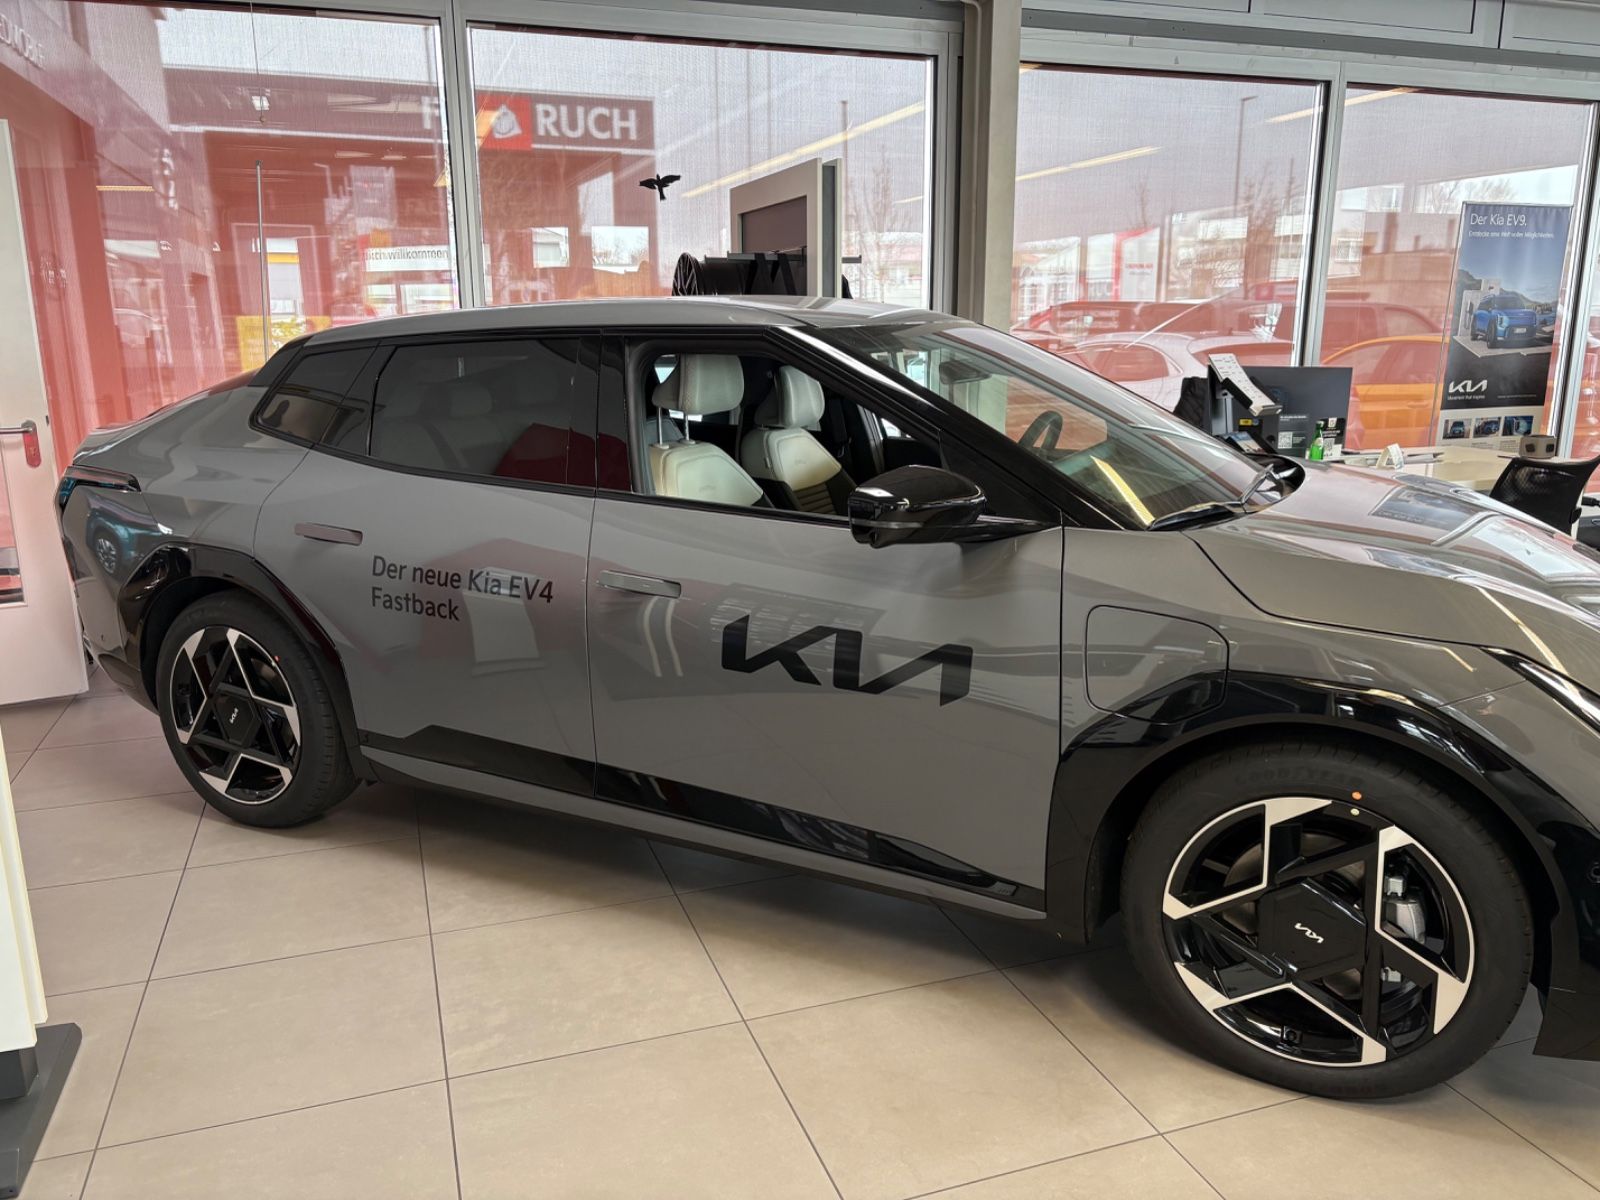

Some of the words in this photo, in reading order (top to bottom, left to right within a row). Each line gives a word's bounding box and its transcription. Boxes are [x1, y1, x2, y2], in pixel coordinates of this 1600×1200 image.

[535, 103, 638, 141] RUCH
[1470, 213, 1488, 225] Der
[1490, 213, 1504, 225] Kia
[1448, 380, 1488, 393] KIA
[372, 555, 407, 580] Der
[412, 566, 461, 589] neue
[468, 569, 501, 596] Kia
[509, 576, 553, 604] EV4
[371, 587, 460, 622] Fastback
[721, 614, 974, 707] KIA
